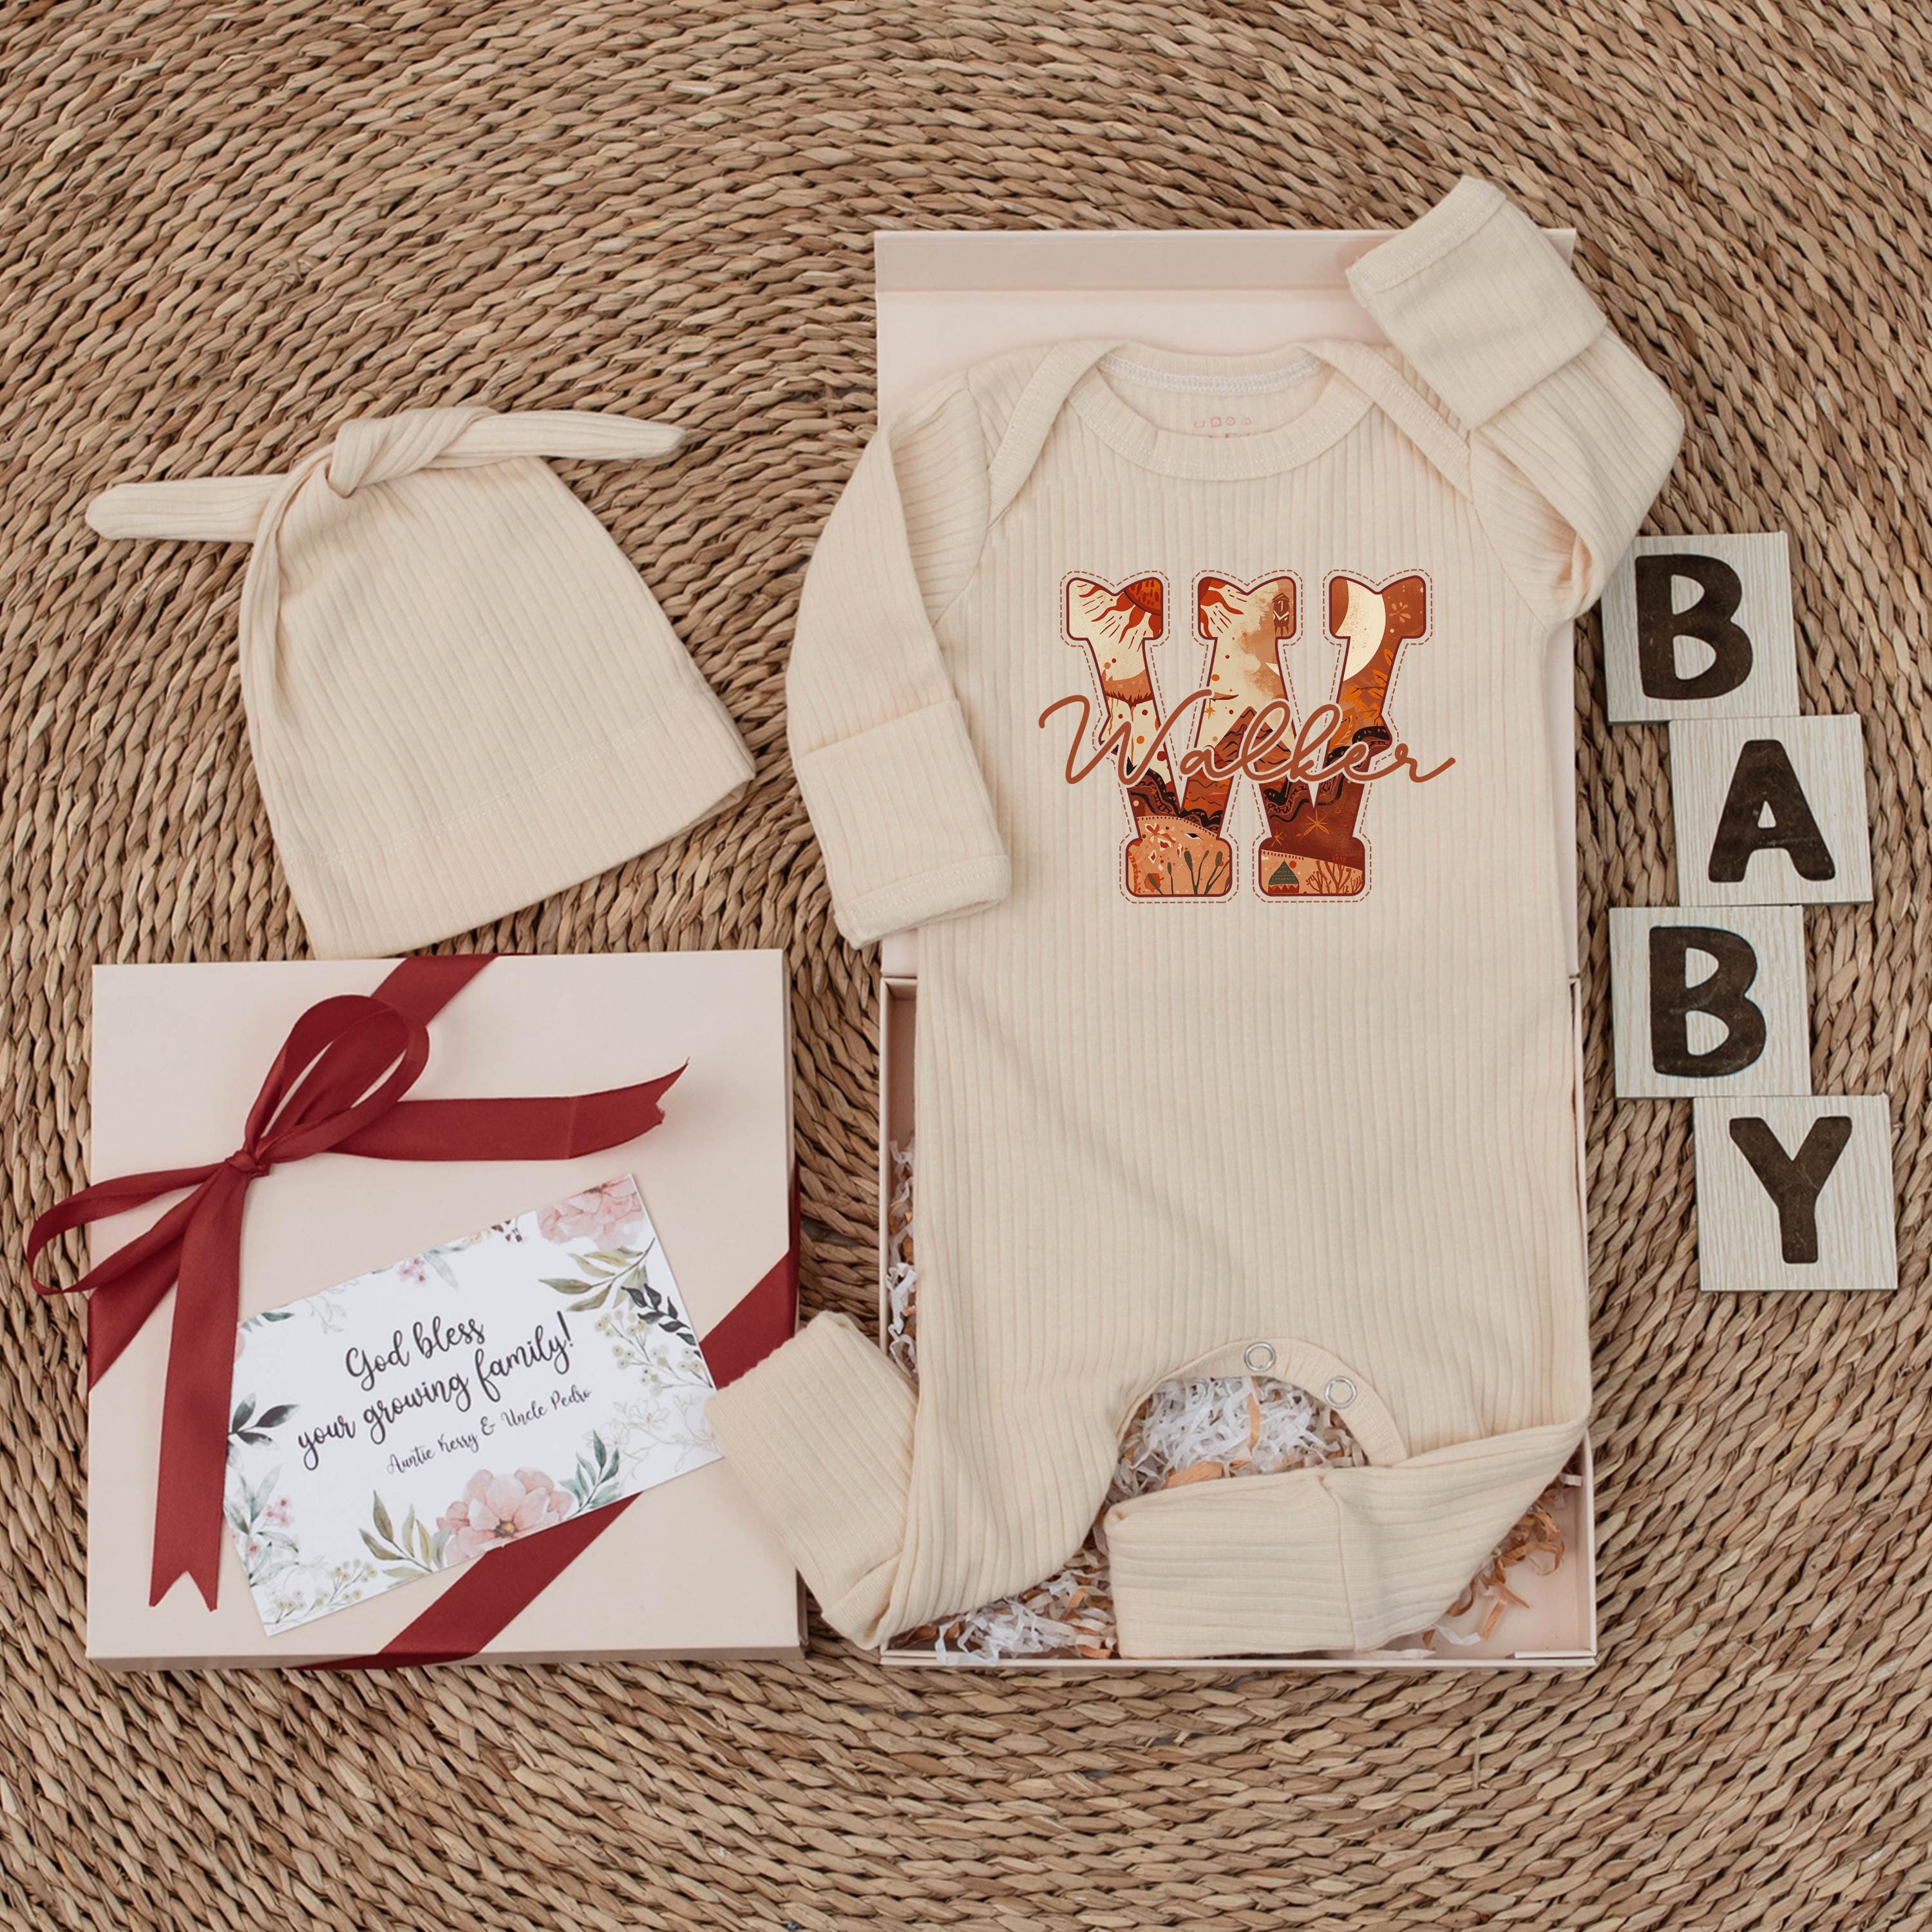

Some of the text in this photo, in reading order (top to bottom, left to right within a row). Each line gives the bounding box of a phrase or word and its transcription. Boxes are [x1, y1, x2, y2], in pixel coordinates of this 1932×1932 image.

[1039, 690, 1456, 784] Walker
[298, 1311, 574, 1471] your growing family!
[346, 1316, 485, 1391] God bless
[387, 1384, 591, 1475] Auntie Kerry & Uncle Pedro
